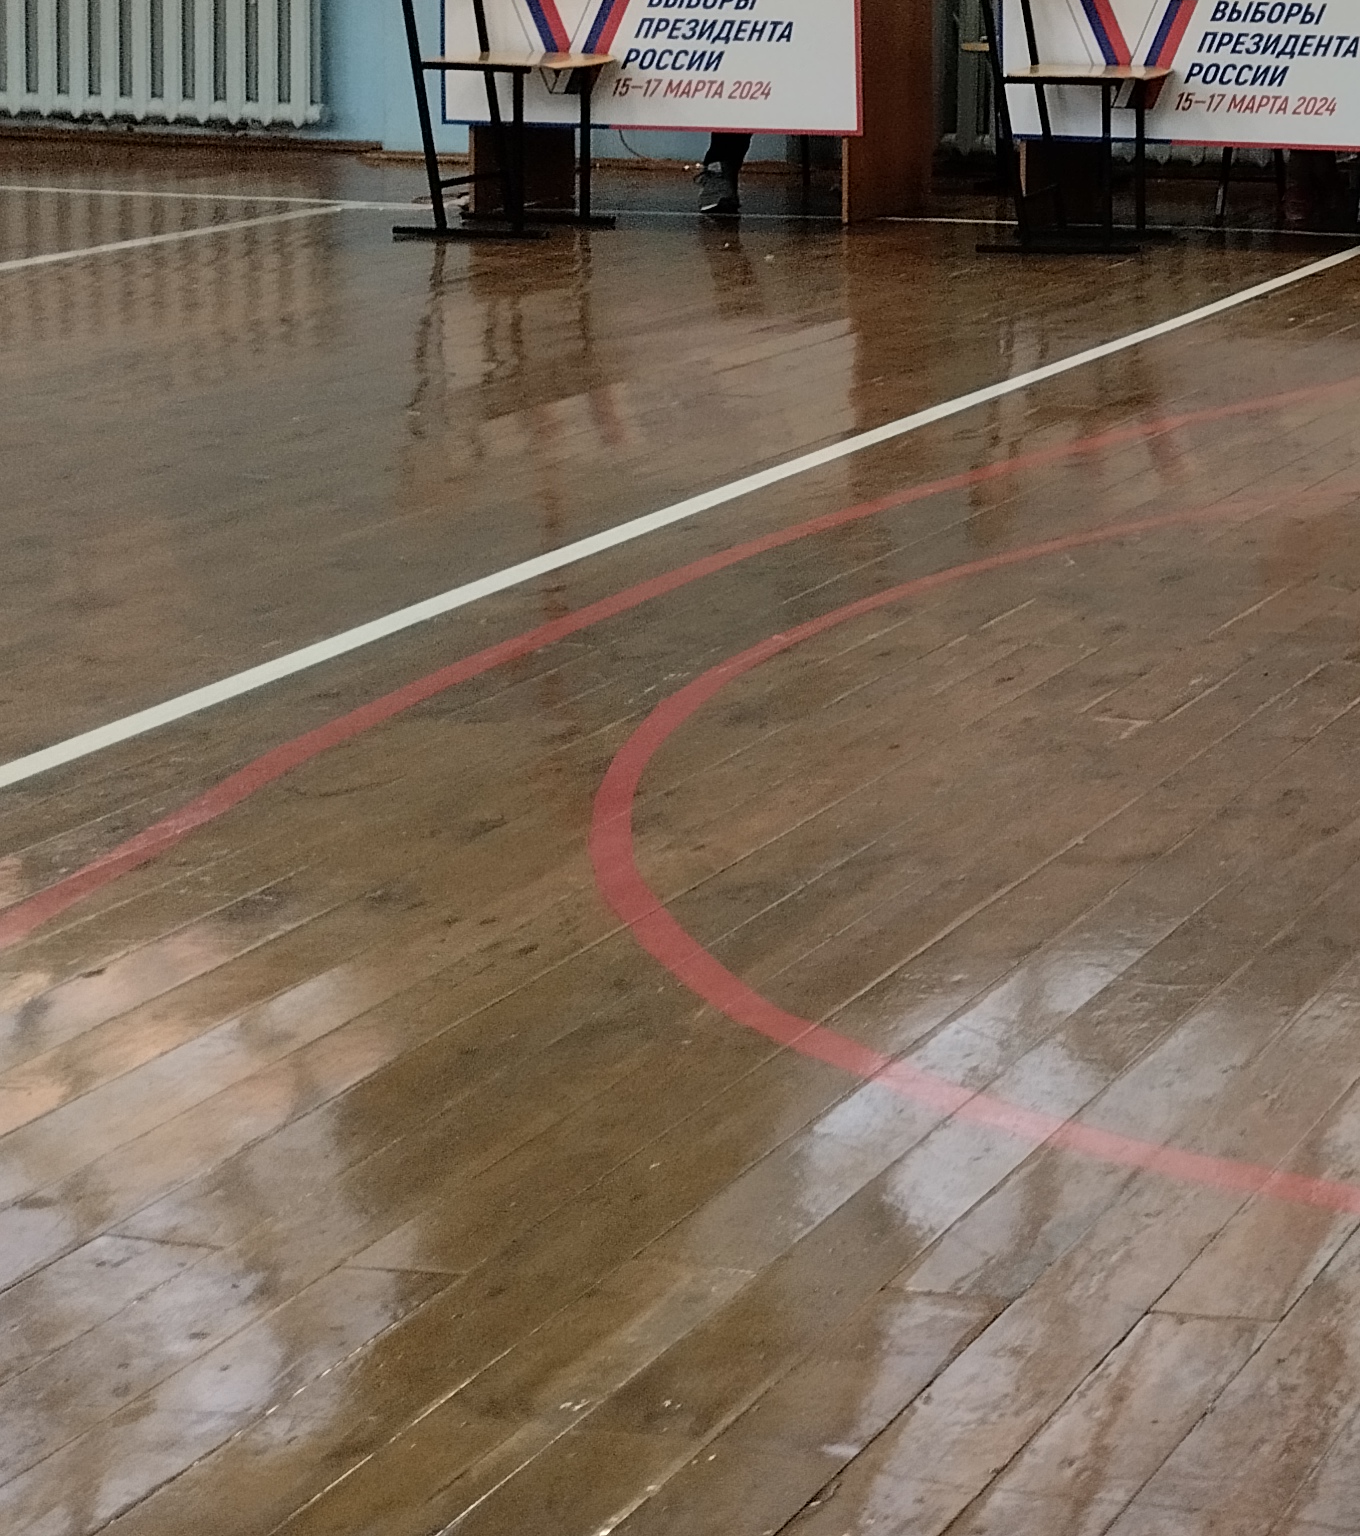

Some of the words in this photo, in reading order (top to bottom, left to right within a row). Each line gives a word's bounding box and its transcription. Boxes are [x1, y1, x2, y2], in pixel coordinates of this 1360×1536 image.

[1210, 0, 1327, 25] ВЫБОРЫ
[634, 17, 794, 44] ПРЕЗИДЕНТА
[1197, 31, 1360, 59] ПРЕЗИДЕНТА
[621, 48, 725, 72] РОССИИ
[1184, 62, 1289, 88] РОССИИ
[663, 78, 725, 100] МАРТА
[728, 80, 772, 101] 2024
[1226, 93, 1289, 115] МАРТА
[1292, 96, 1337, 117] 2024
